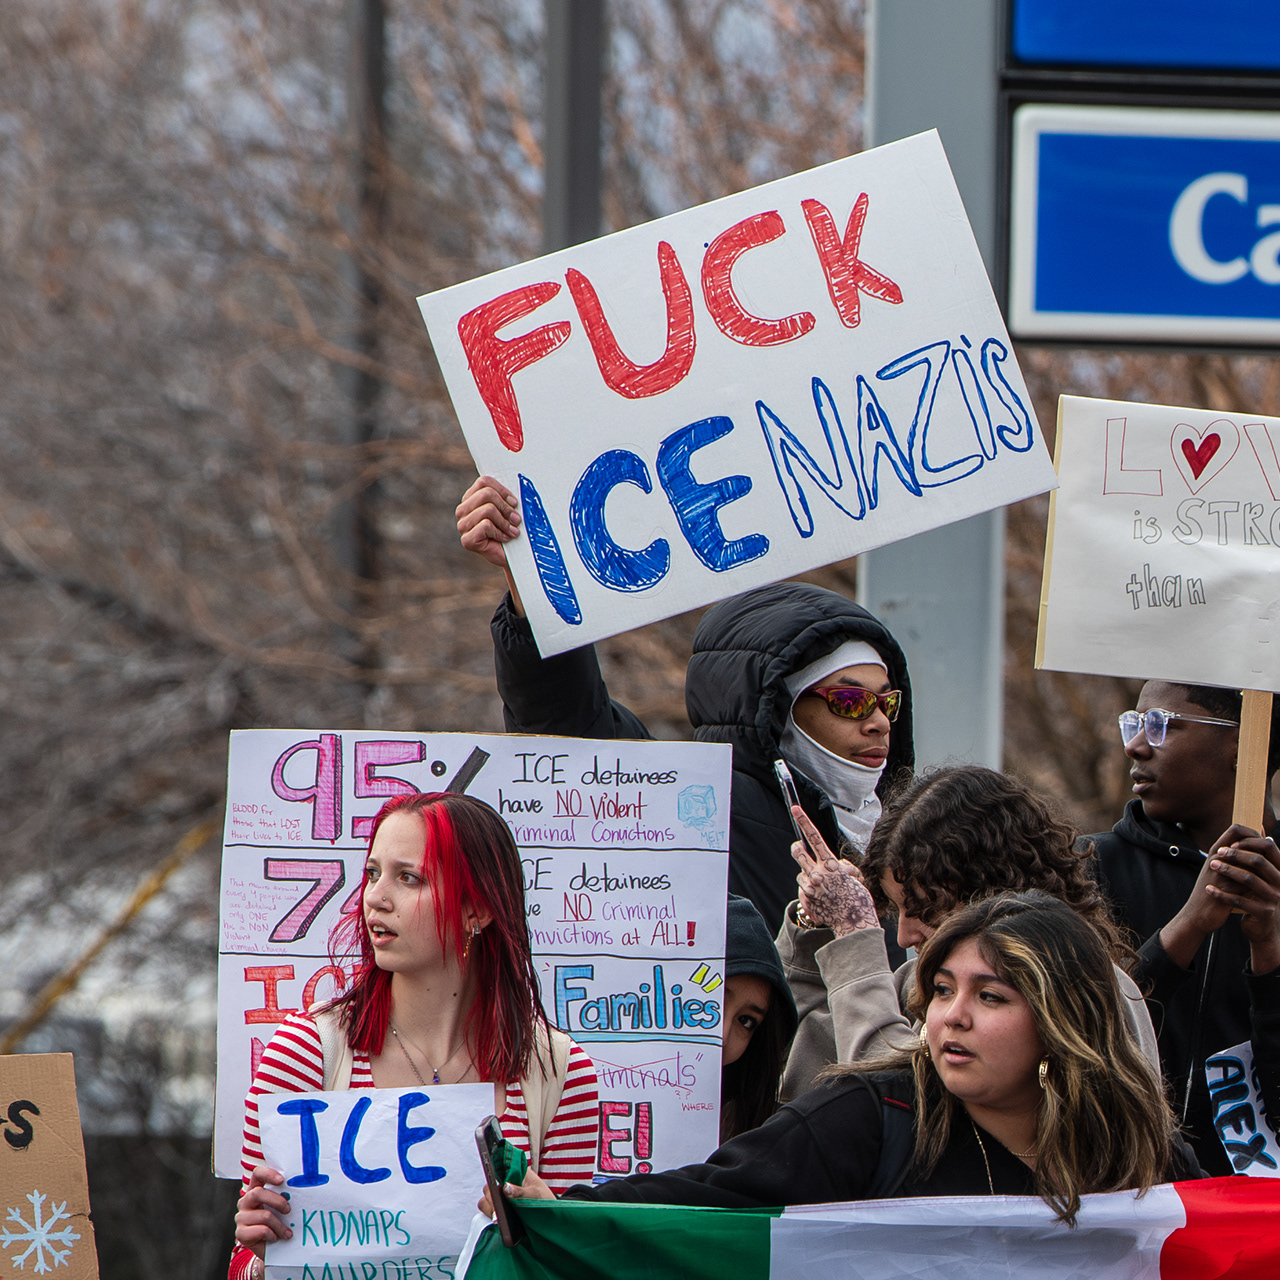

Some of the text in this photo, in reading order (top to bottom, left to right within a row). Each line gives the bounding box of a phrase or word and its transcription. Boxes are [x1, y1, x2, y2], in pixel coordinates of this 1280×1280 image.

[457, 192, 903, 453] FUCK
[517, 416, 771, 626] ICE
[1132, 508, 1162, 544] is
[1125, 563, 1206, 611] than
[512, 752, 679, 787] ICE detainees
[498, 788, 544, 815] have
[555, 788, 583, 816] NO
[568, 861, 672, 893] detainees
[562, 891, 593, 921] NO
[621, 928, 641, 946] at
[650, 920, 697, 947] ALL!
[681, 1102, 715, 1112] WHERE
[276, 1091, 448, 1188] ICE
[302, 1208, 411, 1247] KIDNAPS
